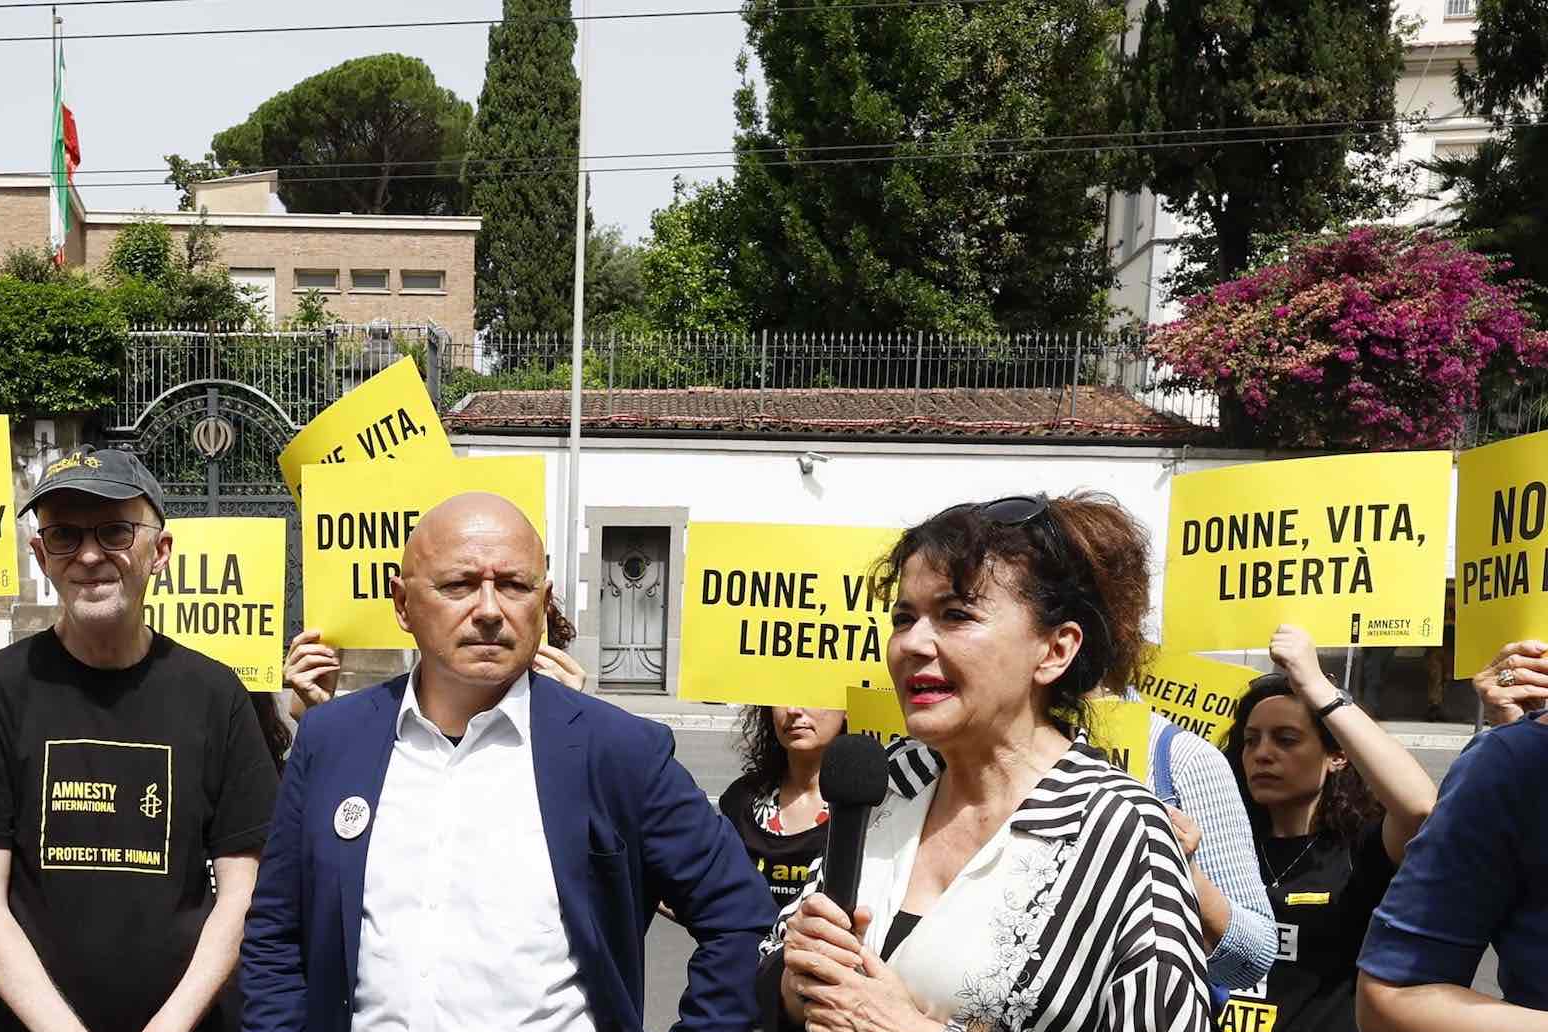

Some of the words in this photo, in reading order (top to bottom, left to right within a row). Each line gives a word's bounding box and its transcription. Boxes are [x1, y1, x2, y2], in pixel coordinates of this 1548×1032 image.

[356, 407, 427, 460] VITA,
[1182, 508, 1310, 556] DONNE,
[1326, 503, 1427, 548] VITA,
[1491, 481, 1548, 547] NO
[152, 553, 244, 597] ALLA
[701, 568, 827, 616] DONNE,
[1218, 547, 1374, 601] LIBERTÀ
[1462, 550, 1531, 606] PENA
[176, 601, 275, 637] MORTE
[739, 616, 882, 663] LIBERTÀ
[1367, 618, 1411, 629] AMNESTY
[1139, 673, 1198, 709] RIETÀ
[51, 781, 117, 801] AMNESTY
[51, 799, 117, 813] INTERNATIONAL
[47, 847, 99, 862] PROTECT
[101, 848, 123, 863] THE
[124, 849, 161, 866] HUMAN
